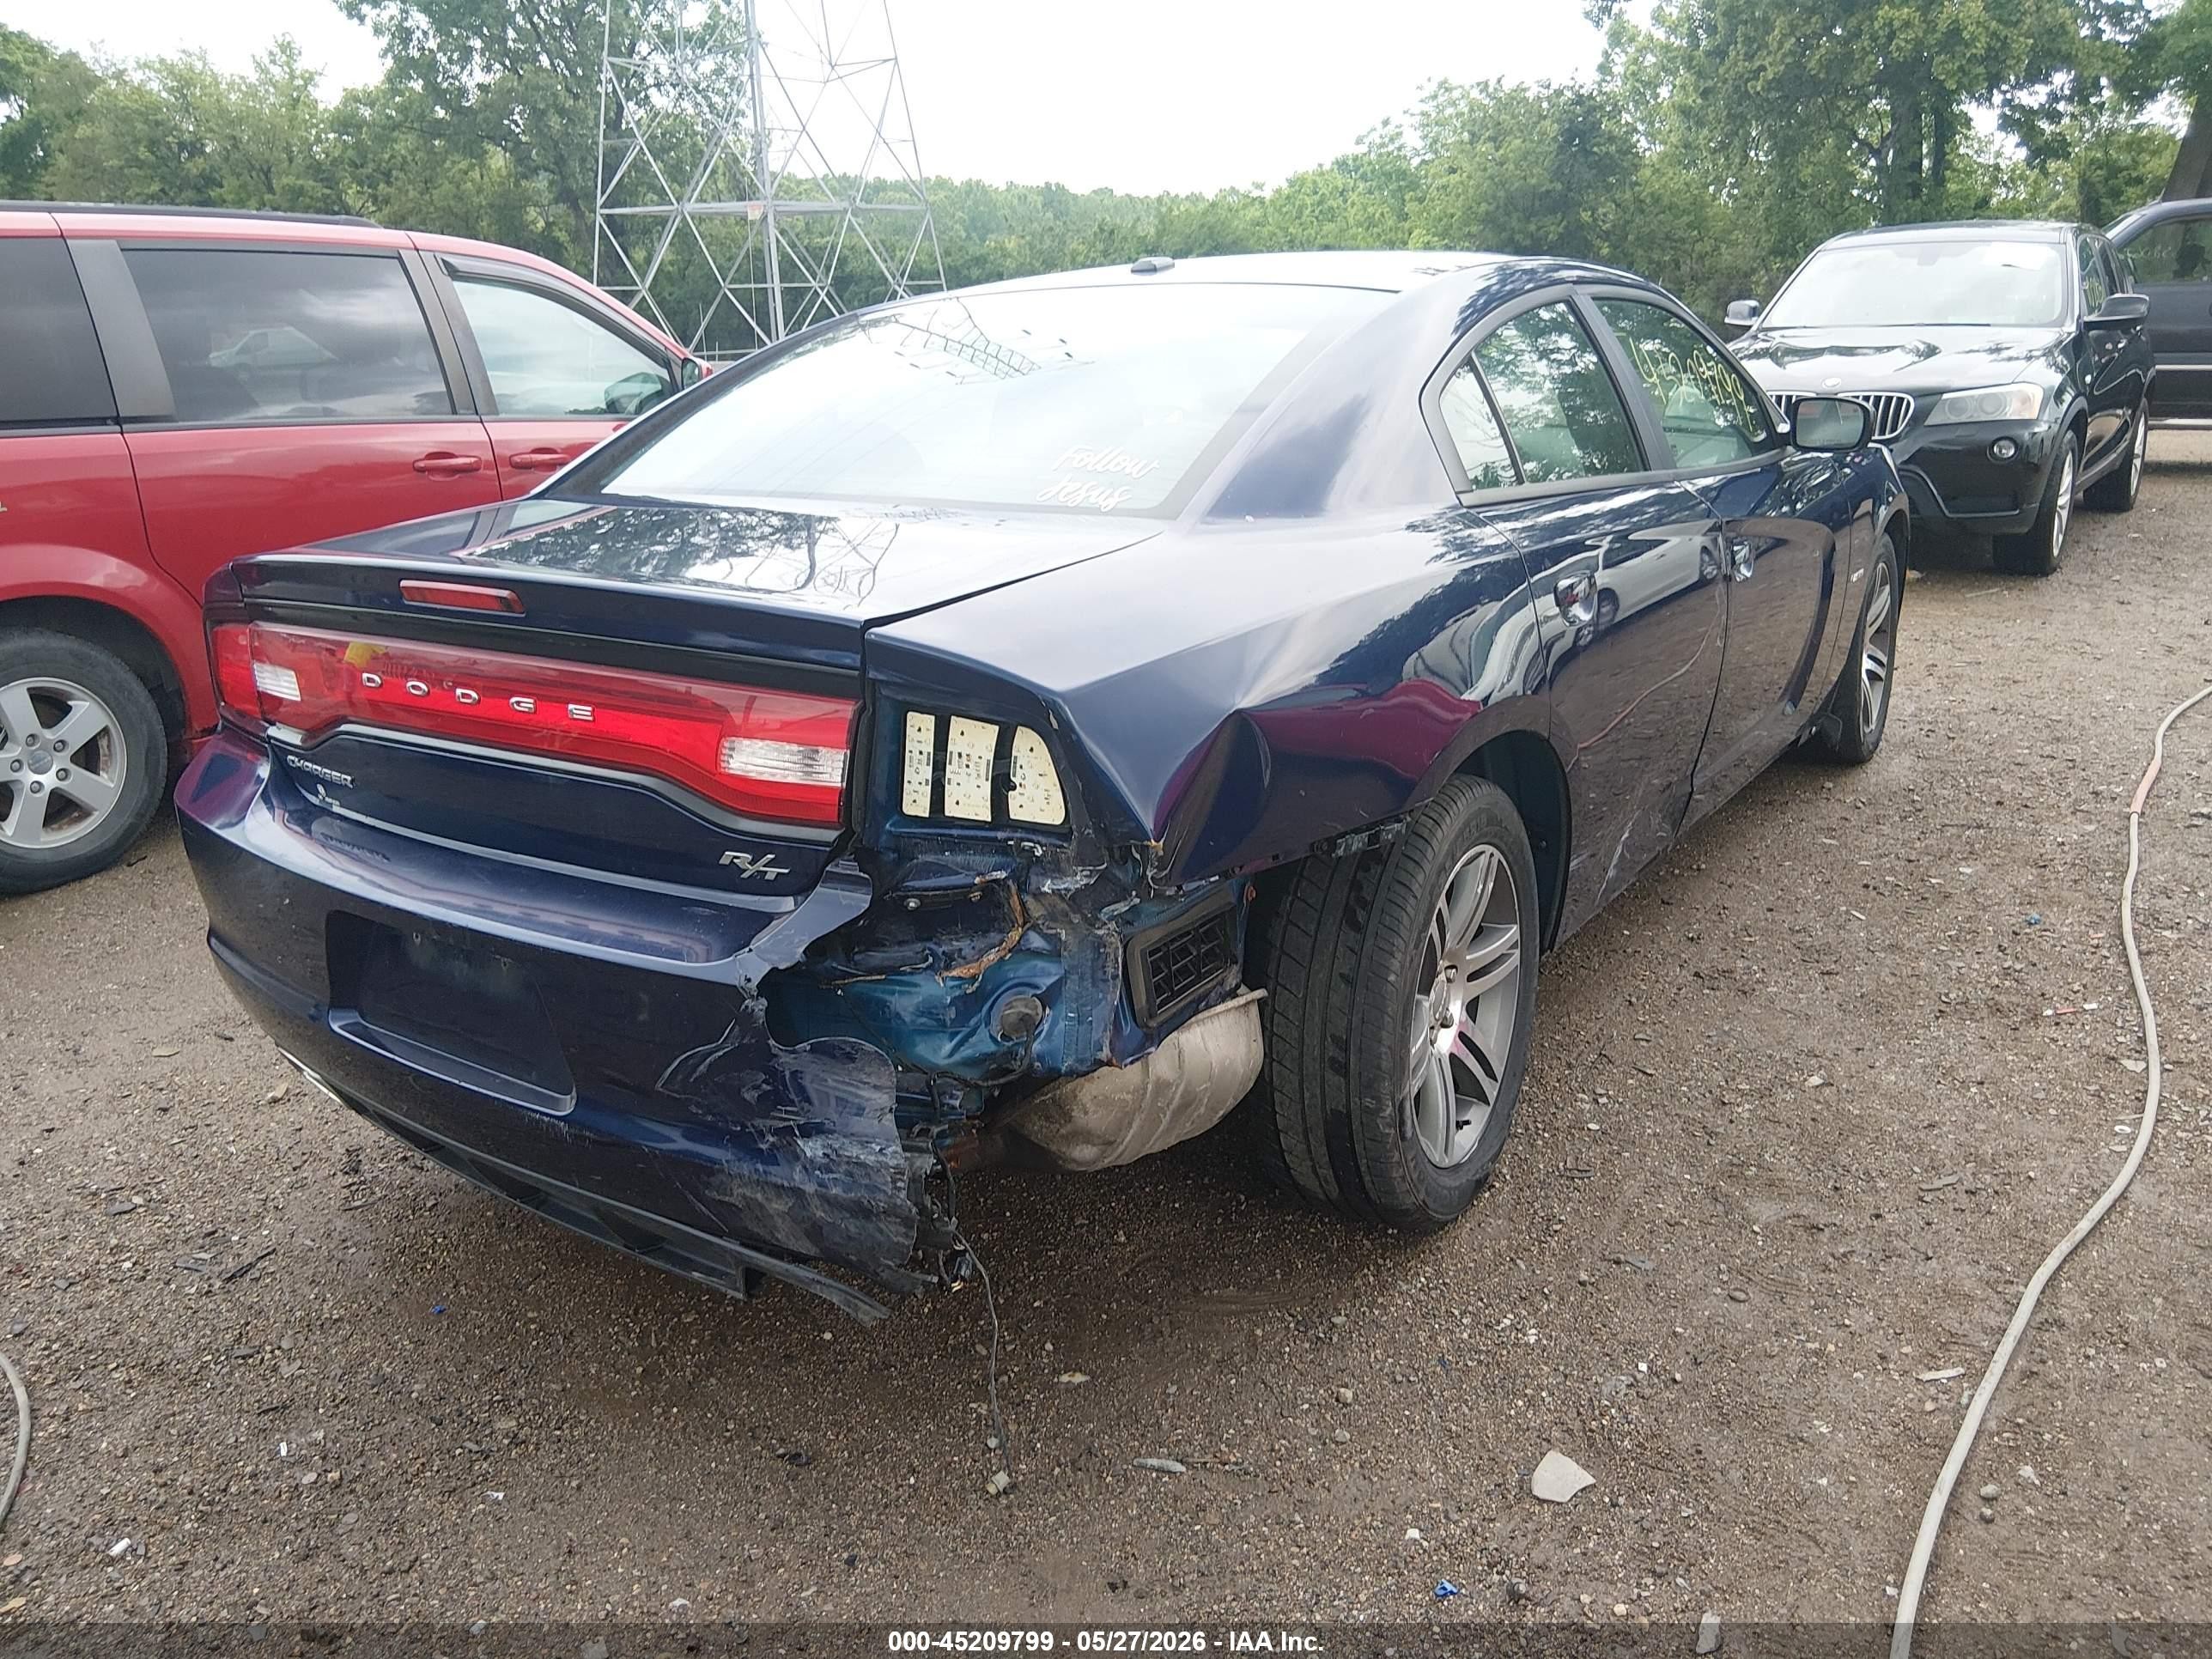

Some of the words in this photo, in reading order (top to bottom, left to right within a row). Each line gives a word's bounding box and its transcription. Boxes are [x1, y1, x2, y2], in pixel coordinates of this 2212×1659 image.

[1050, 444, 1160, 479] Follow
[1036, 473, 1133, 513] Jesus
[361, 672, 596, 722] DODGE
[286, 755, 354, 789] CHARGER
[718, 850, 791, 881] R/T
